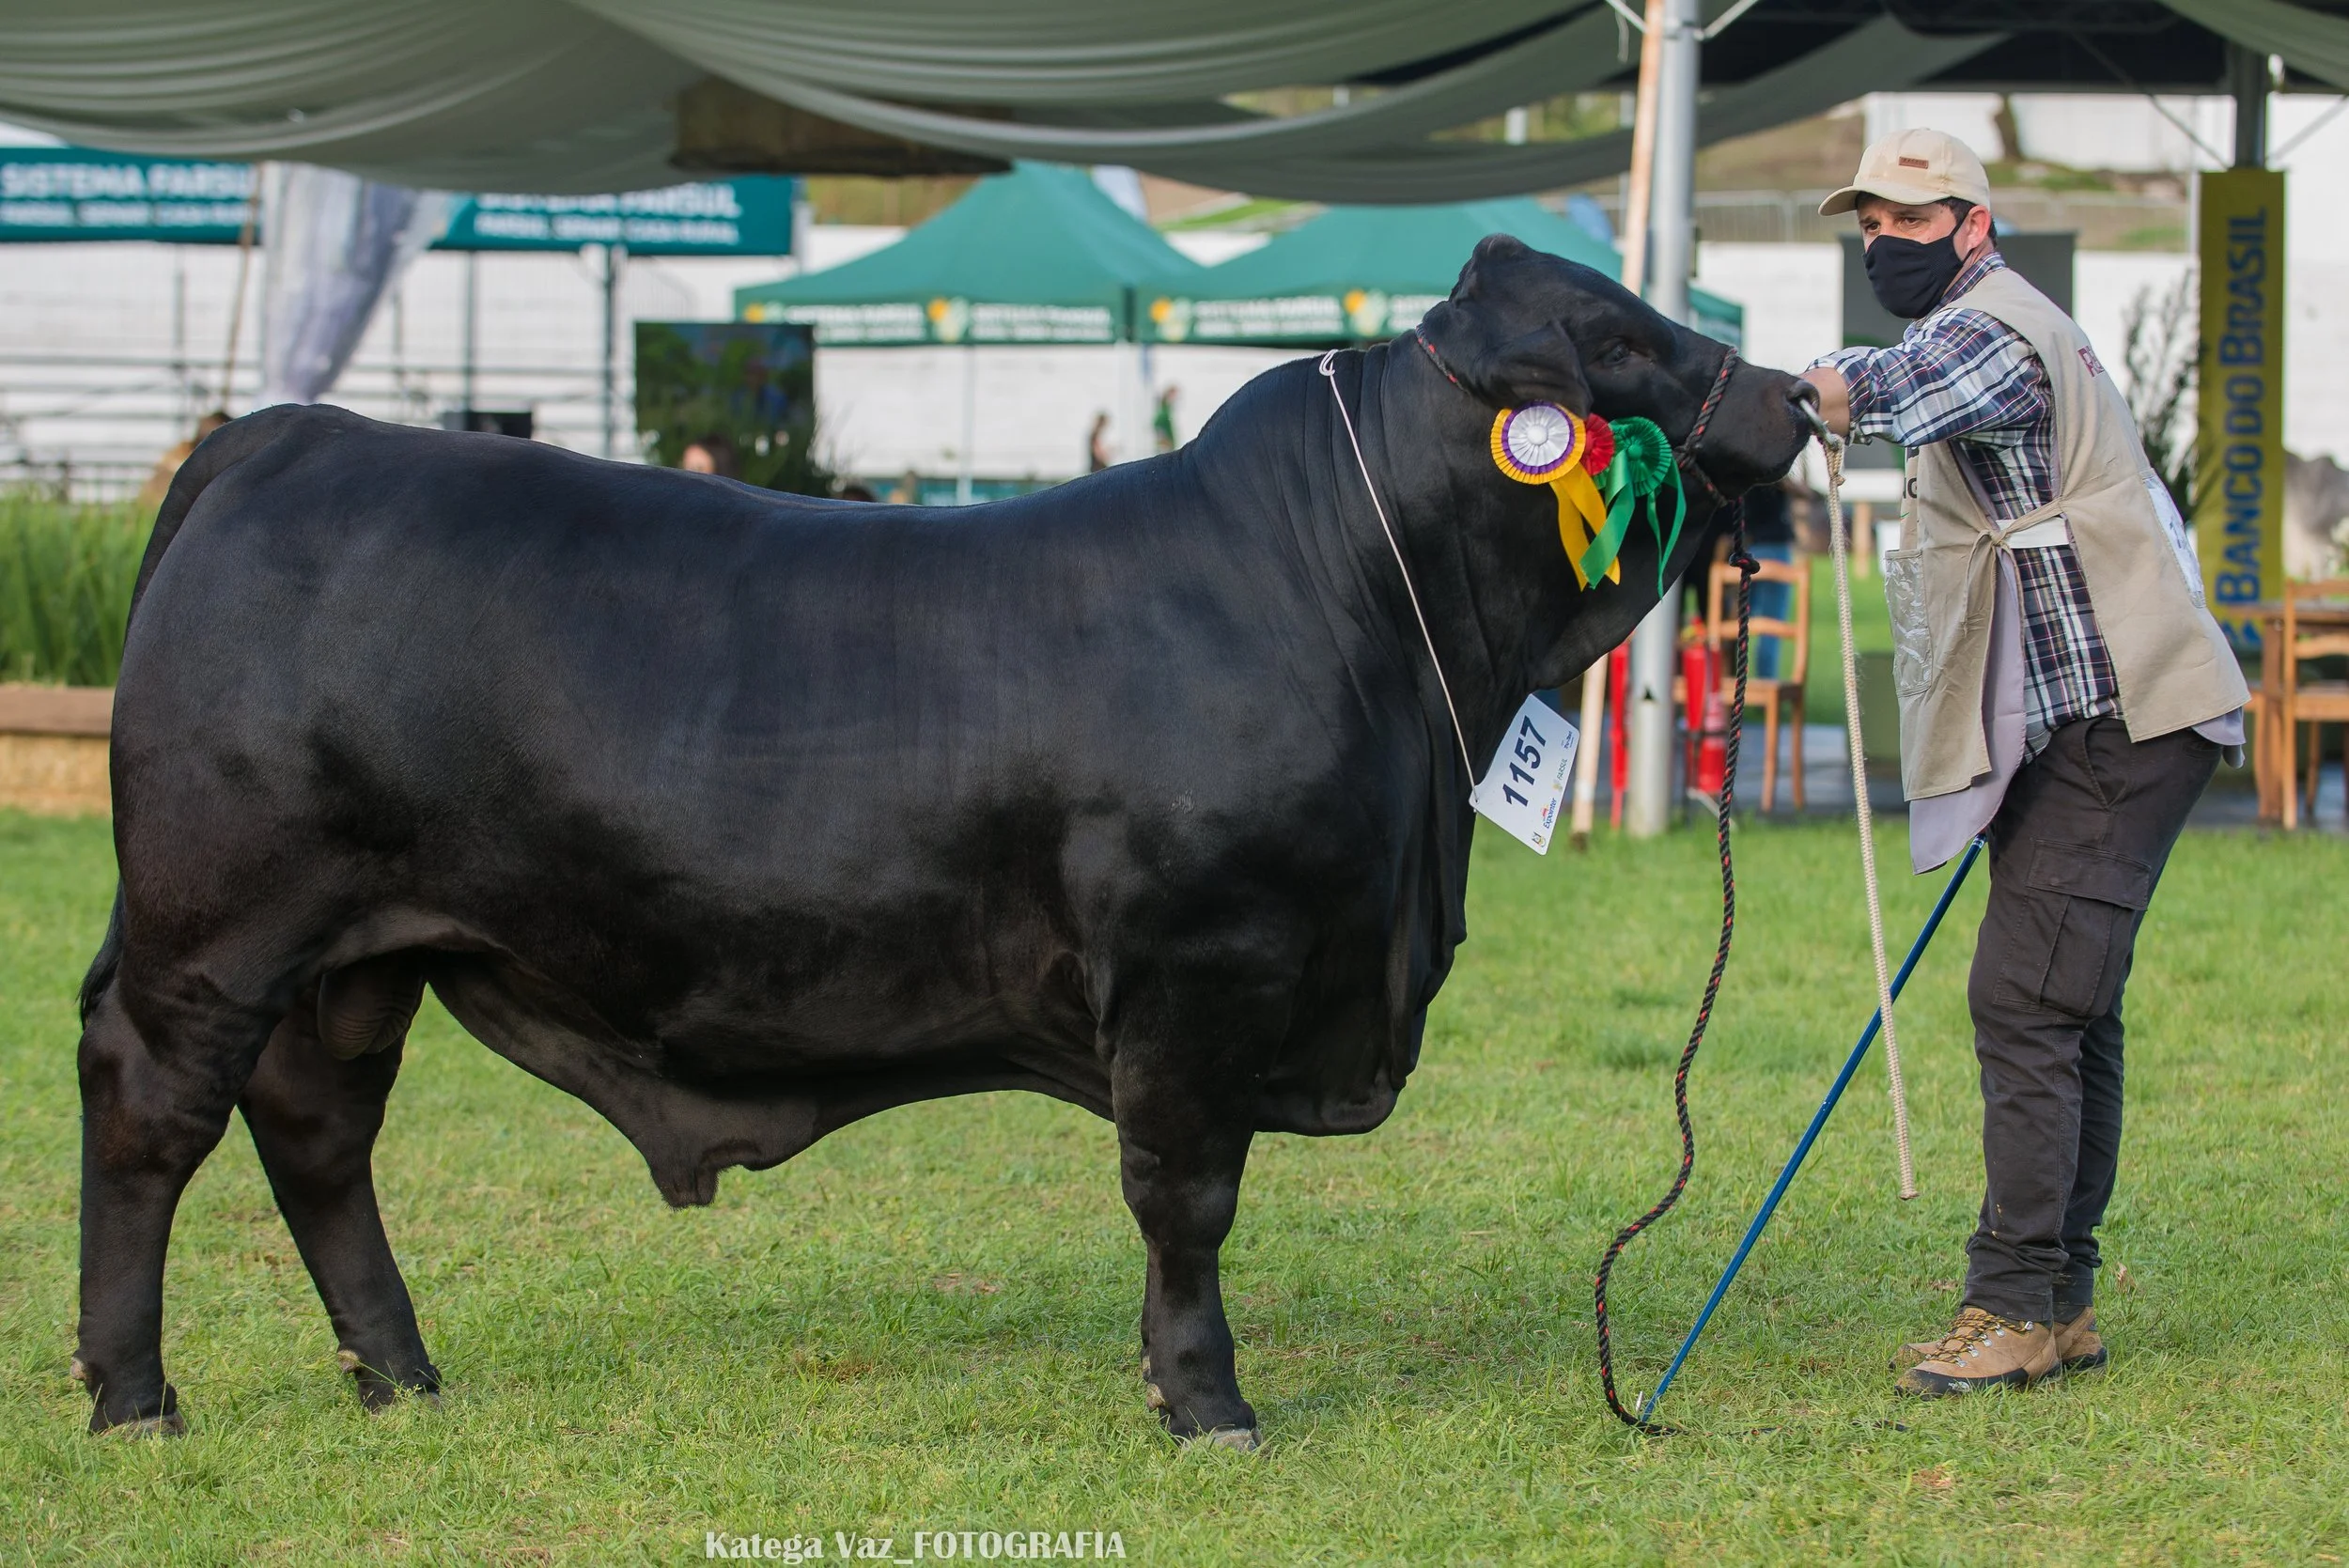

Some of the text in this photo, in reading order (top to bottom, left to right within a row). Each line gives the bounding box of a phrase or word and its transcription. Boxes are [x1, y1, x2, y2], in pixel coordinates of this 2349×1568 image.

[2215, 207, 2266, 604] BANCO DO BRASIL
[1503, 715, 1546, 806] 1157
[1543, 798, 1557, 829] Expointer
